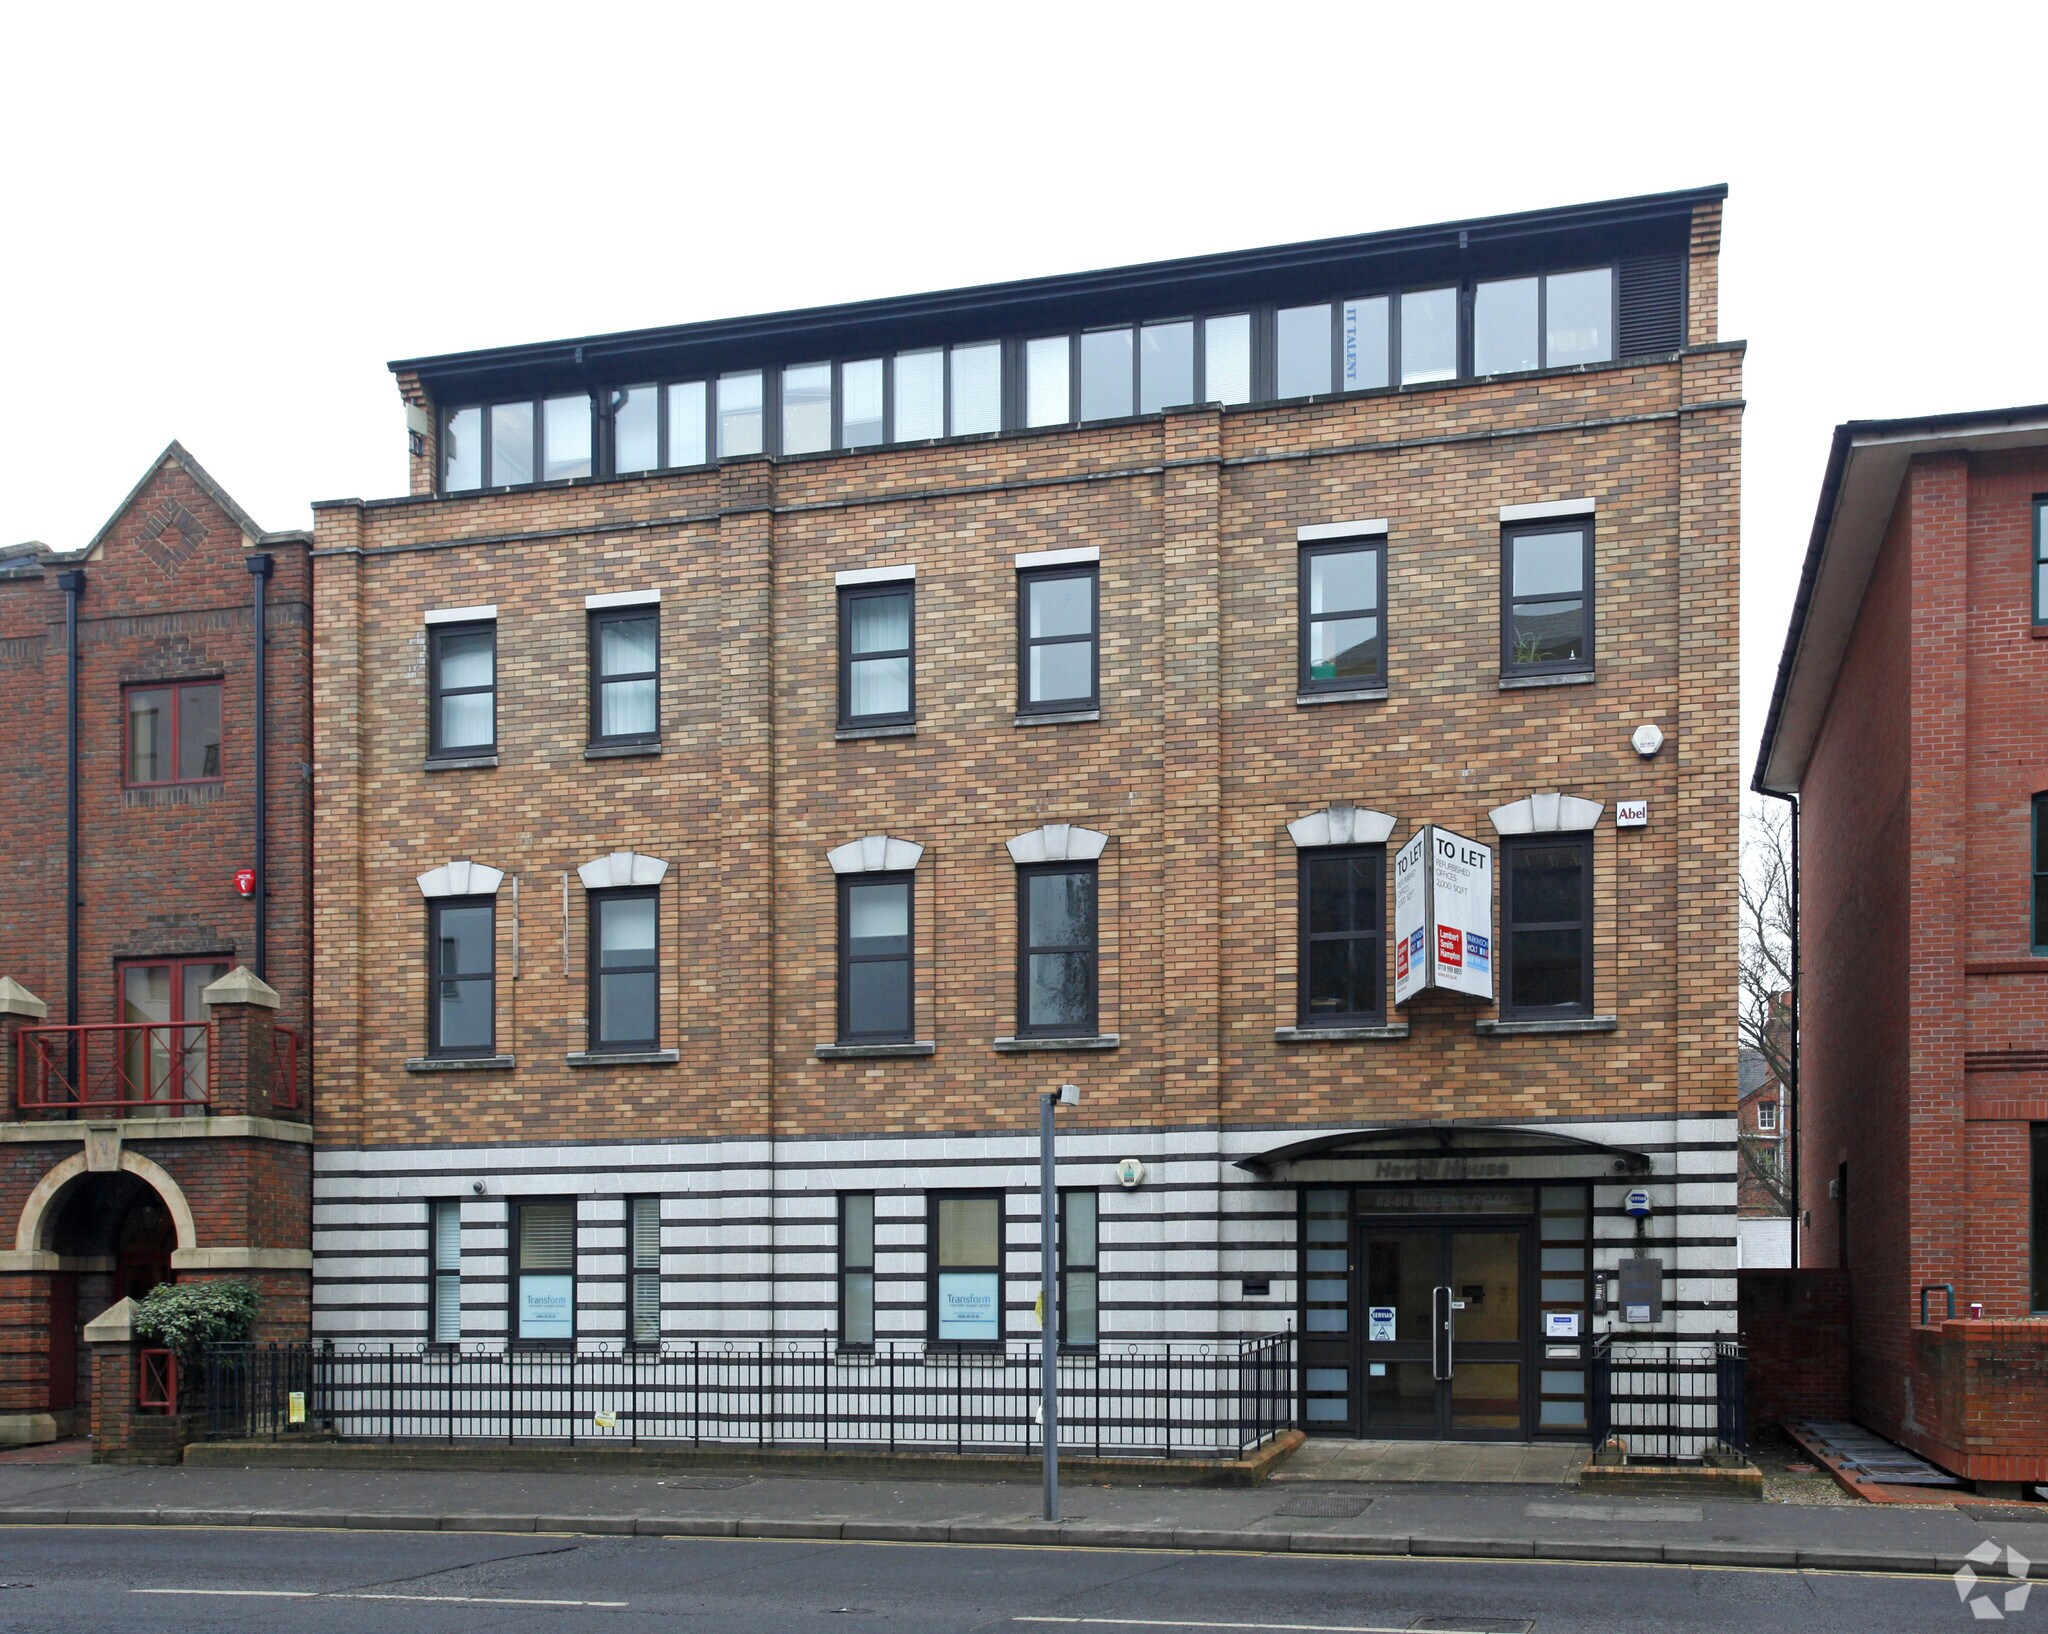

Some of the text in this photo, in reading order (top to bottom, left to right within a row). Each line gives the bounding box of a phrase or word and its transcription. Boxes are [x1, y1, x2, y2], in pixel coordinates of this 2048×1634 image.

[1347, 308, 1357, 380] IT TALENT
[1618, 806, 1646, 820] Abel
[1398, 841, 1423, 876] TO LET
[1436, 838, 1486, 869] TO LET
[1436, 859, 1471, 877] REFURBISHED
[1436, 869, 1457, 882] OFFICES
[1440, 929, 1459, 942] Lambert
[1440, 939, 1454, 950] Smith
[1467, 944, 1478, 952] HOLT
[1440, 948, 1461, 961] Hampton
[1442, 1159, 1511, 1177] House
[1413, 1194, 1469, 1207] QUEENS
[1472, 1194, 1512, 1206] ROAD
[527, 1295, 566, 1305] Transform
[947, 1293, 991, 1304] Transform
